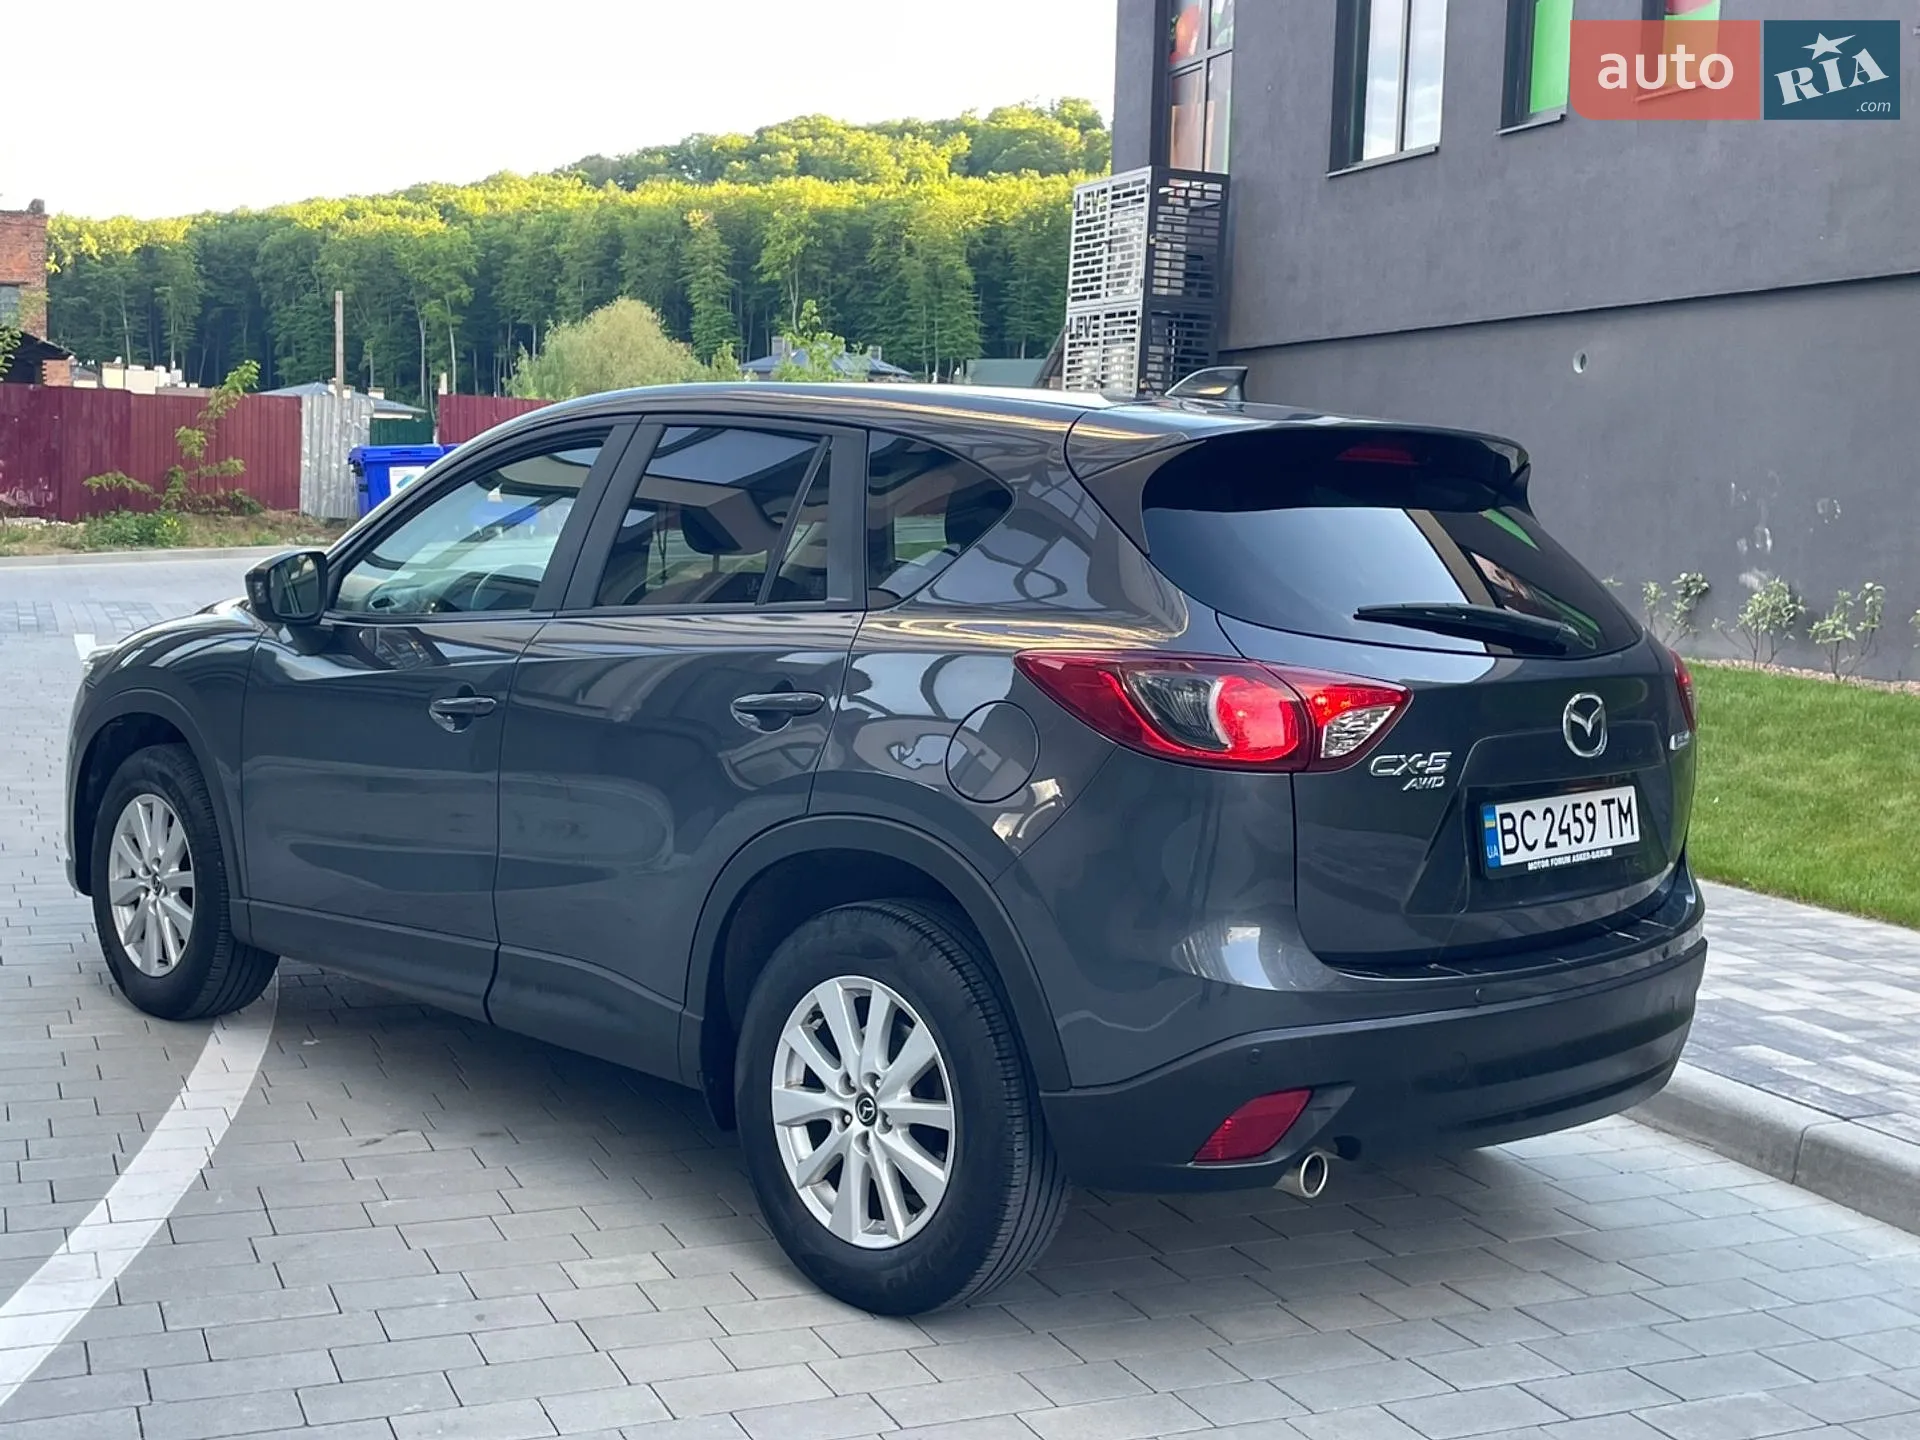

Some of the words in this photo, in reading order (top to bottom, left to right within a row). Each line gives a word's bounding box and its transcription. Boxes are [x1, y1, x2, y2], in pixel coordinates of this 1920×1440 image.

[1370, 751, 1452, 776] CX-5
[1402, 775, 1445, 791] AWD
[1499, 811, 1539, 856] BC
[1543, 802, 1597, 849] 2459
[1601, 796, 1635, 839] TM
[1486, 846, 1499, 858] UA
[1527, 858, 1551, 871] MOTOR
[1550, 855, 1572, 867] FORUM
